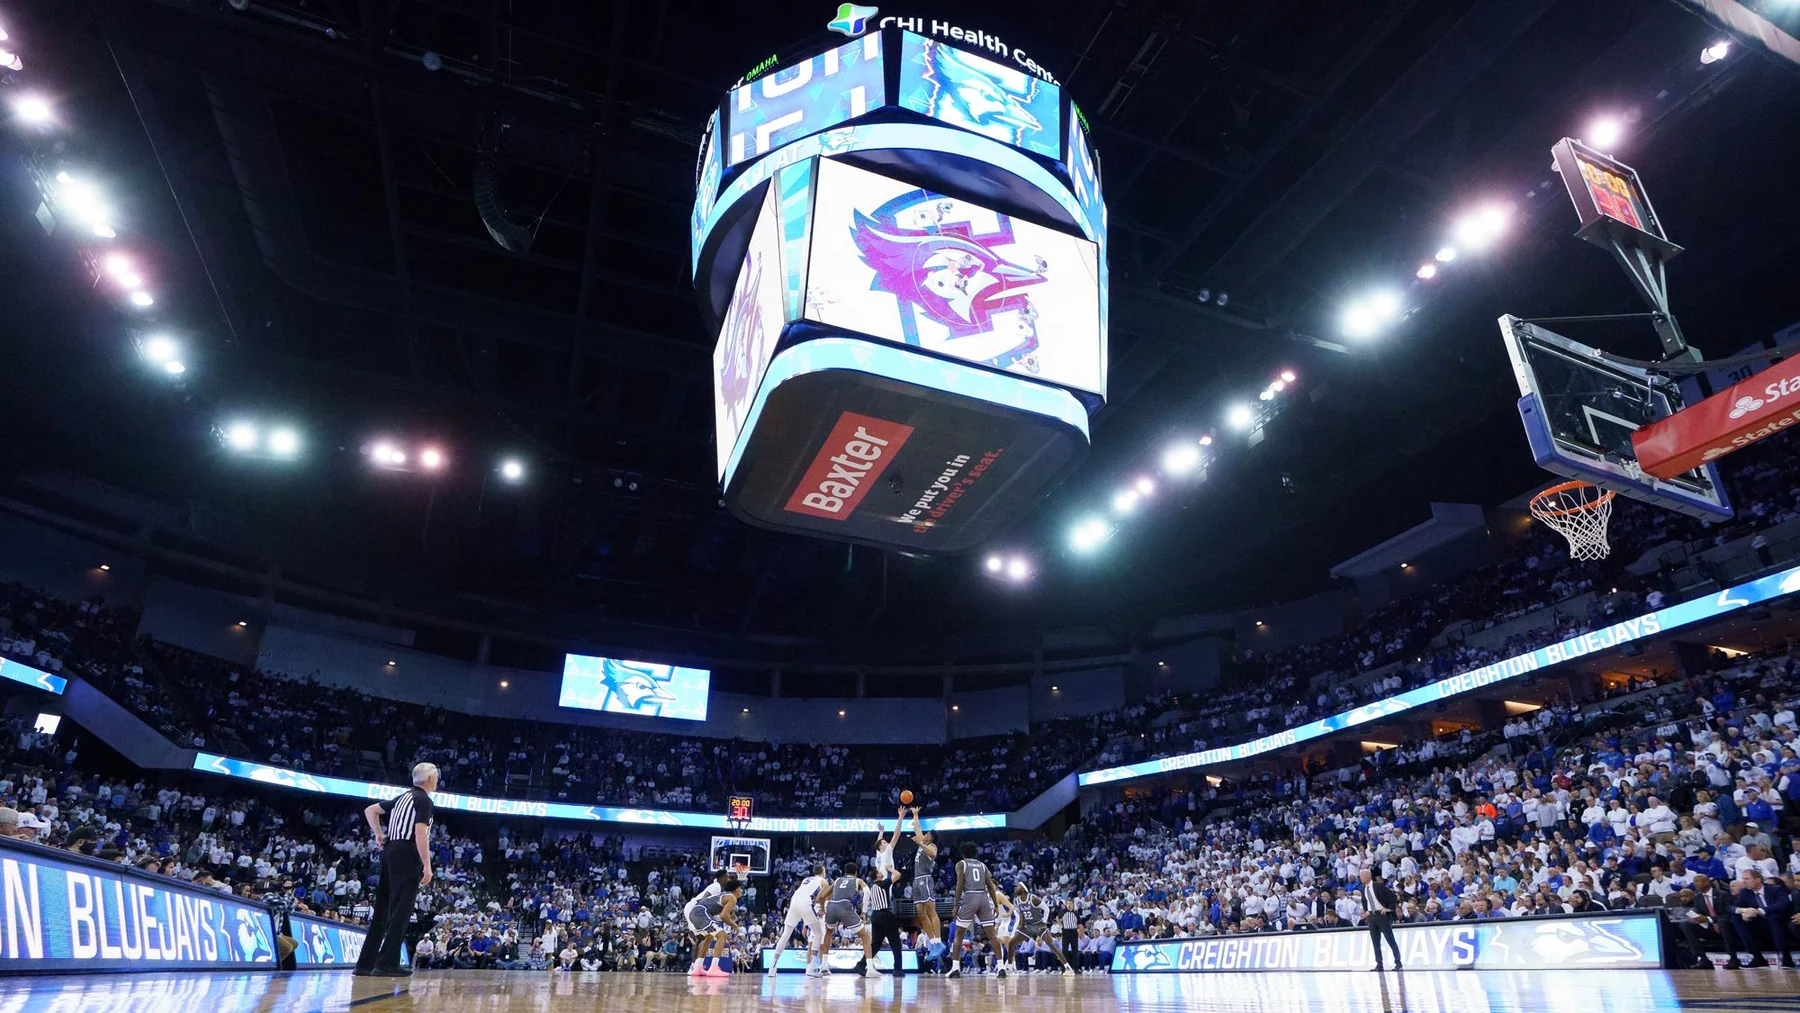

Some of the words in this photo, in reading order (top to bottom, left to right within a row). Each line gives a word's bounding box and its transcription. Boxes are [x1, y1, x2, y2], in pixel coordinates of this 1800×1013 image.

[880, 17, 923, 32] CHI
[932, 20, 1008, 57] Health
[746, 54, 778, 81] OMAHA
[1732, 417, 1794, 446] State
[802, 426, 889, 513] Baxter
[898, 508, 922, 523] We
[914, 489, 939, 509] put
[931, 468, 959, 491] you
[946, 454, 971, 468] in
[1437, 651, 1538, 698] CREIGHTON
[1546, 613, 1661, 661] BLUEJAYS
[1160, 747, 1232, 772] CREIGHTON
[1238, 730, 1297, 758] BLUEJAYS
[467, 797, 547, 817] BLUEJAYS
[734, 806, 748, 818] 30
[806, 818, 876, 832] BLUEJAYS
[839, 880, 849, 889] 2
[972, 868, 981, 882] 0
[66, 871, 217, 961] BLUEJAYS
[1178, 937, 1300, 970] CREIGHTON
